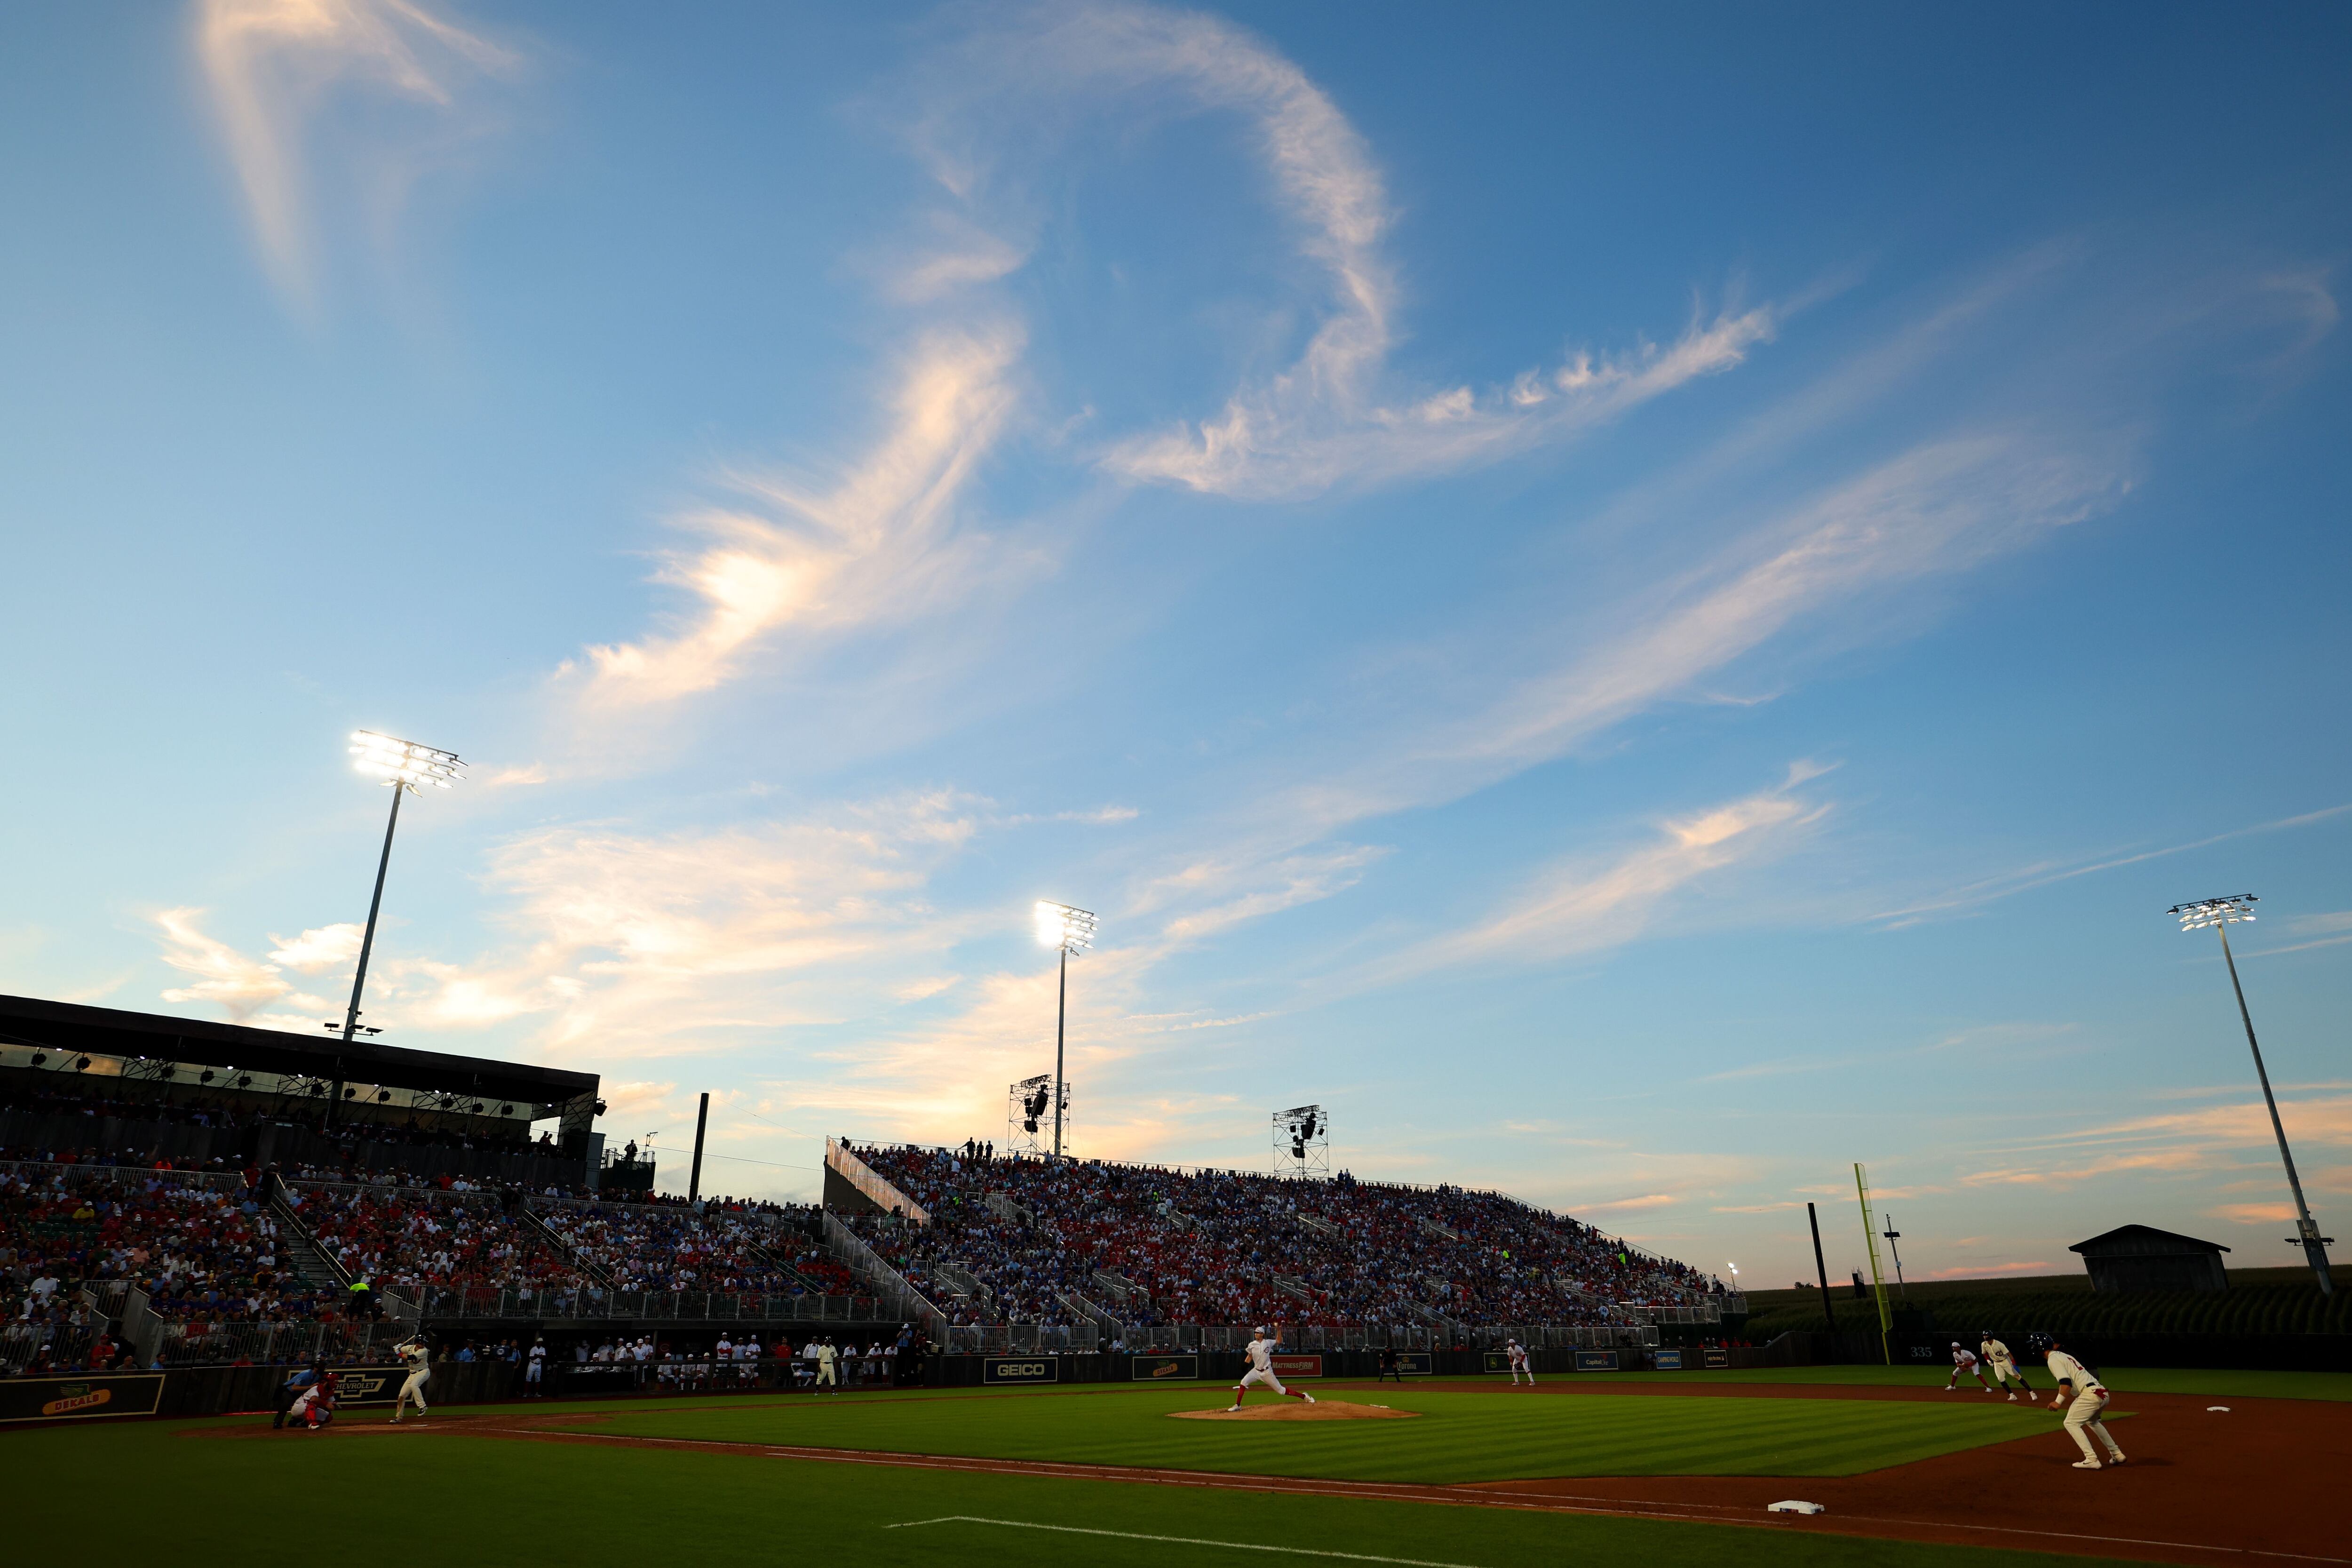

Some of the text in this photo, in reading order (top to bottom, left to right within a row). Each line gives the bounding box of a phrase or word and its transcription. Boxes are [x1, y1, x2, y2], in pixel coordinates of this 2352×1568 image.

[1910, 1346, 1932, 1357] 335
[997, 1363, 1045, 1377] GEICO
[1397, 1361, 1417, 1372] Corona
[335, 1382, 375, 1390] HEVROLET
[55, 1393, 100, 1410] DEKALB
